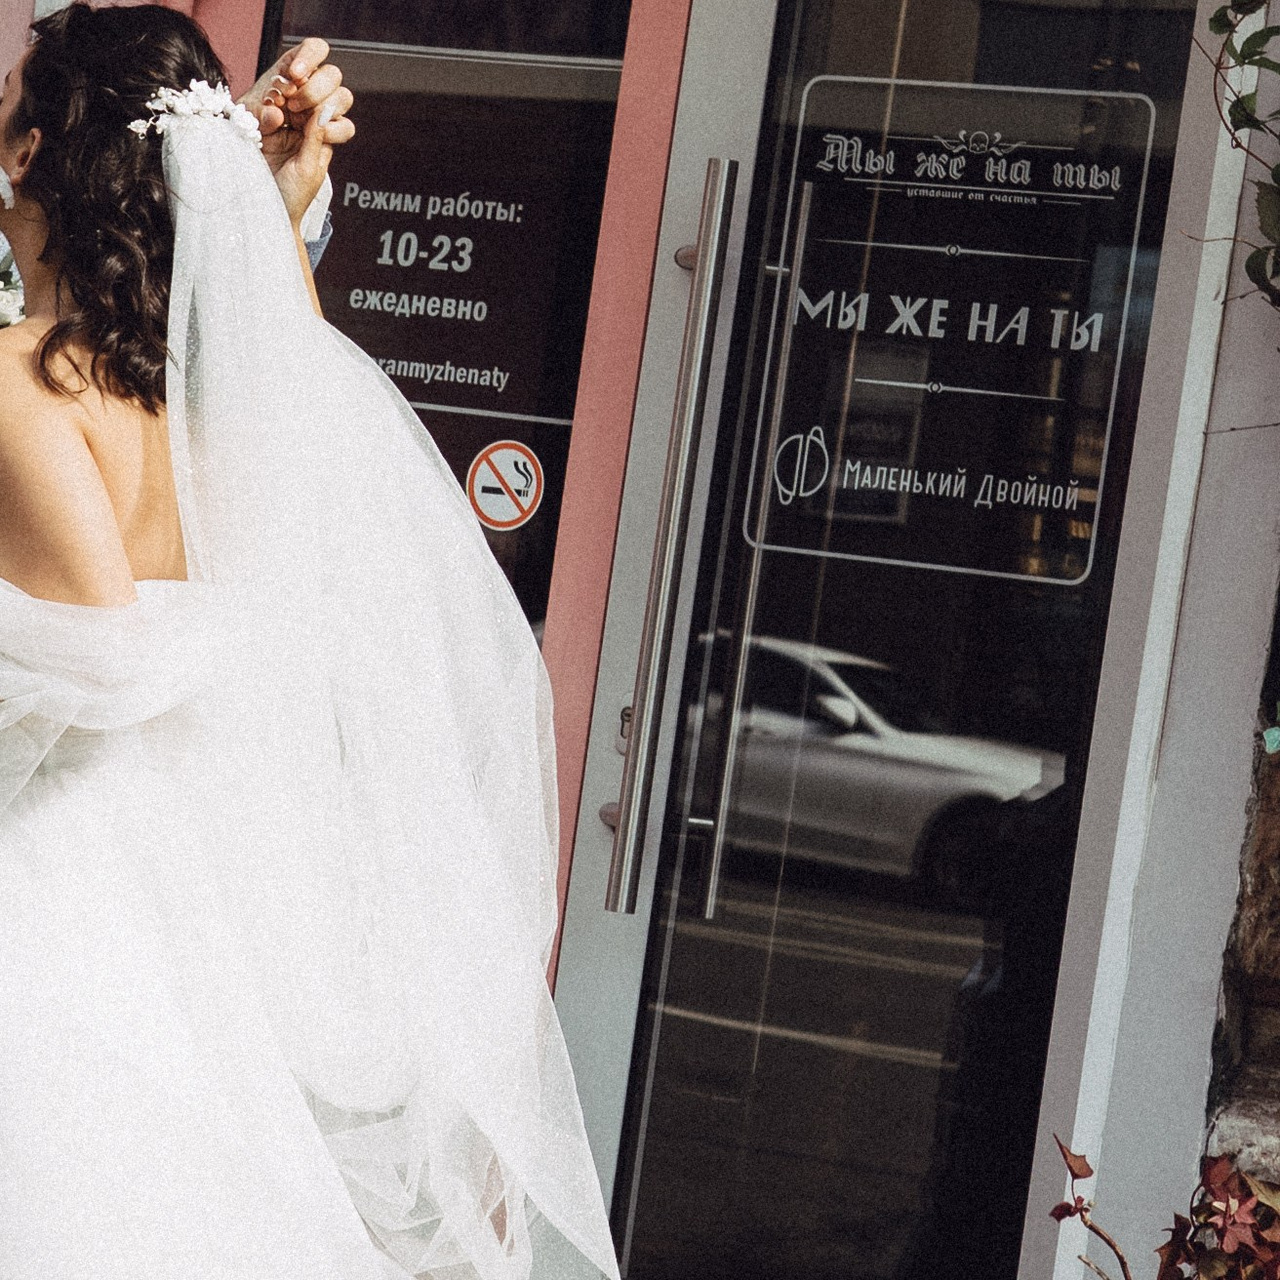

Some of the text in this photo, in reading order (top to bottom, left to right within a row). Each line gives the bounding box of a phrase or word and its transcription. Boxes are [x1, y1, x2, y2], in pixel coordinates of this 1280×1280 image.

[816, 133, 1122, 192] Мы же на ты
[343, 182, 523, 223] Режим работы:
[376, 230, 474, 272] 10-23
[349, 287, 488, 322] ежедневно
[793, 289, 1104, 353] МЫ ЖЕ НА ТЫ
